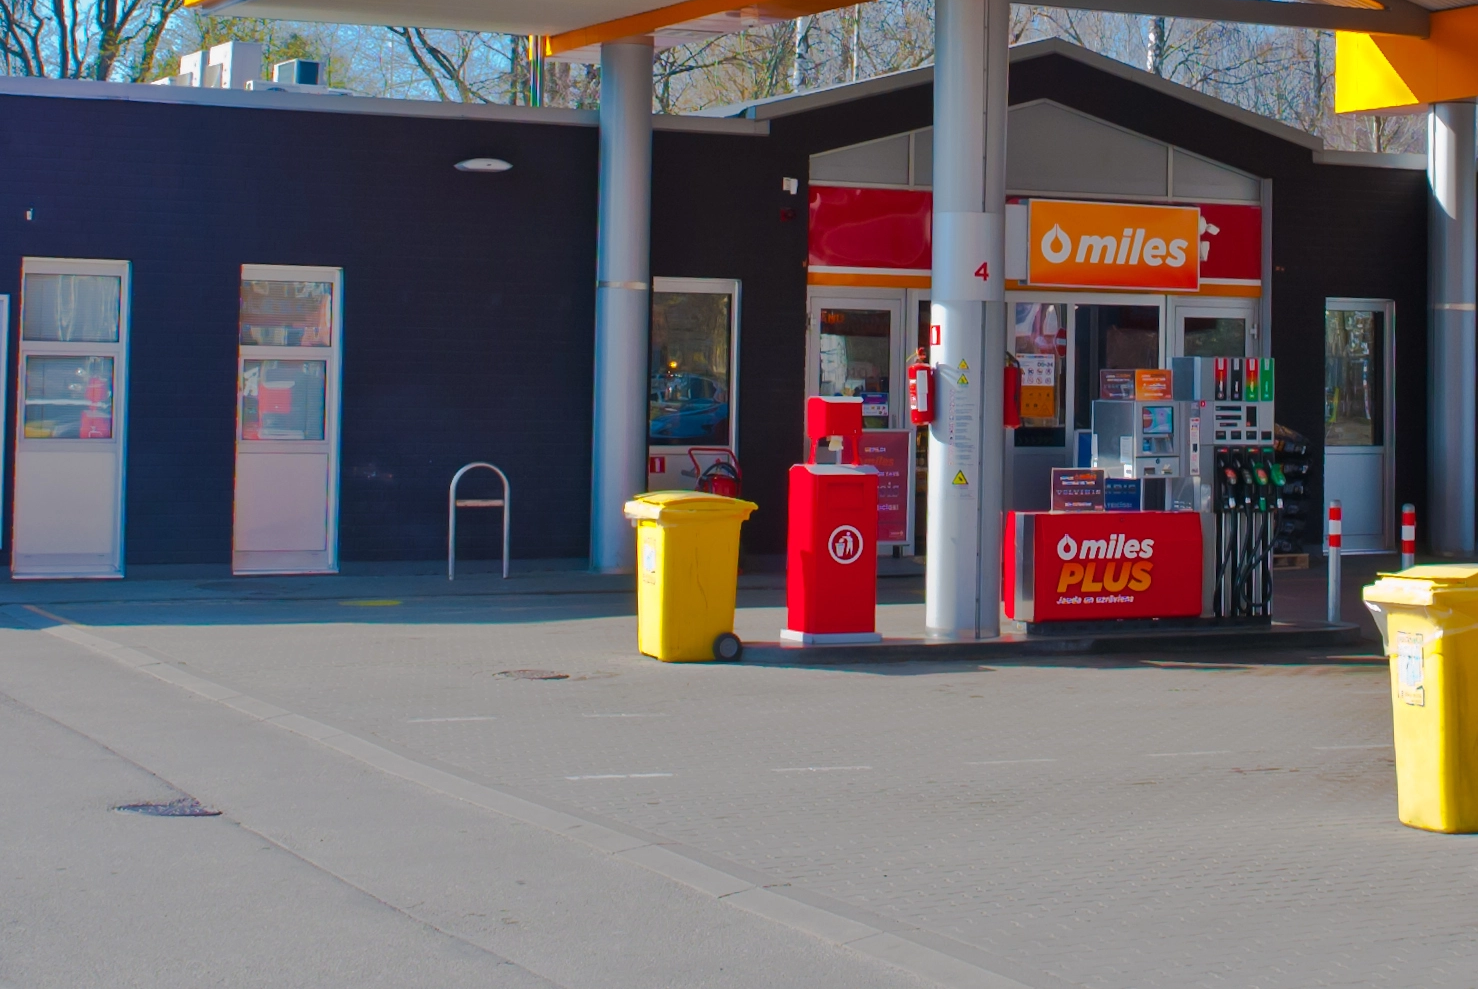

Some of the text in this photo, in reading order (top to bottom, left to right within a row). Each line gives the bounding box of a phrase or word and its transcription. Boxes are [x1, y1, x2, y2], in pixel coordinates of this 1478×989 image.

[1075, 227, 1189, 268] miles
[974, 261, 990, 282] 4
[1079, 533, 1155, 560] miles
[1056, 561, 1154, 594] PLUS
